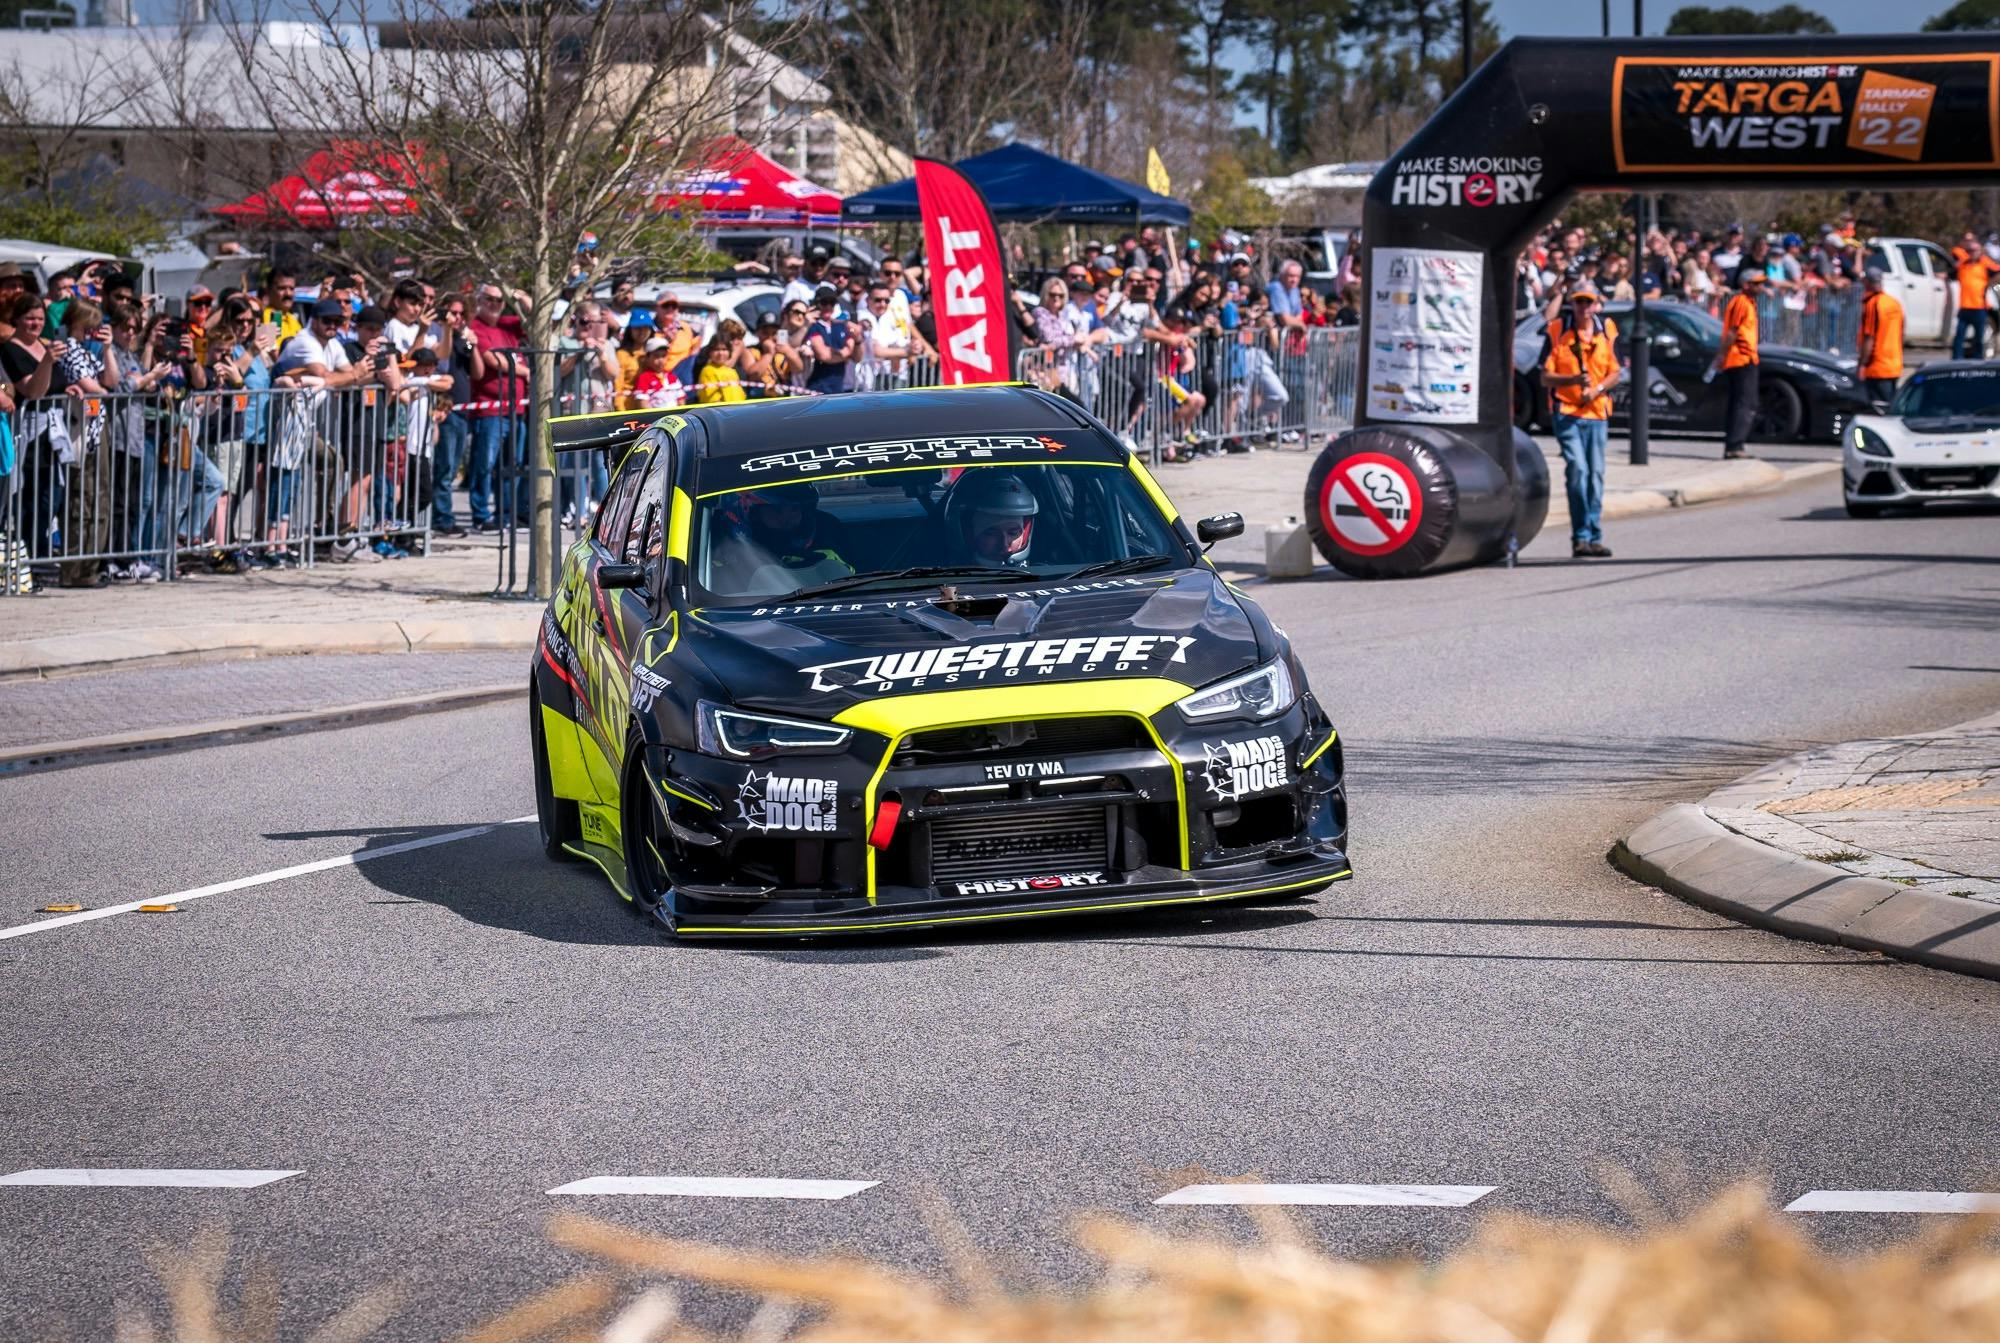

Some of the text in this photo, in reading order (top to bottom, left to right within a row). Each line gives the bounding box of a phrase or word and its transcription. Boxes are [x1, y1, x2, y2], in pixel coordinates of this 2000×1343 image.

[1673, 81, 1843, 114] TARGA
[1859, 102, 1908, 114] RALLY
[1864, 88, 1932, 100] TARMAC
[1689, 116, 1843, 149] WEST
[1398, 156, 1543, 174] MAKE SMOKING
[938, 216, 993, 385] ART
[800, 449, 993, 472] GARAGE
[996, 578, 1143, 598] PRODUCTS
[752, 603, 863, 616] BETTER
[877, 664, 1056, 693] DESIGN
[1229, 737, 1277, 767] MAD
[1270, 735, 1289, 786] CUSTOMS
[993, 761, 1065, 778] EV 07 WA
[1232, 761, 1281, 795] DOG
[766, 776, 824, 803] MAD
[766, 801, 823, 832] DOG
